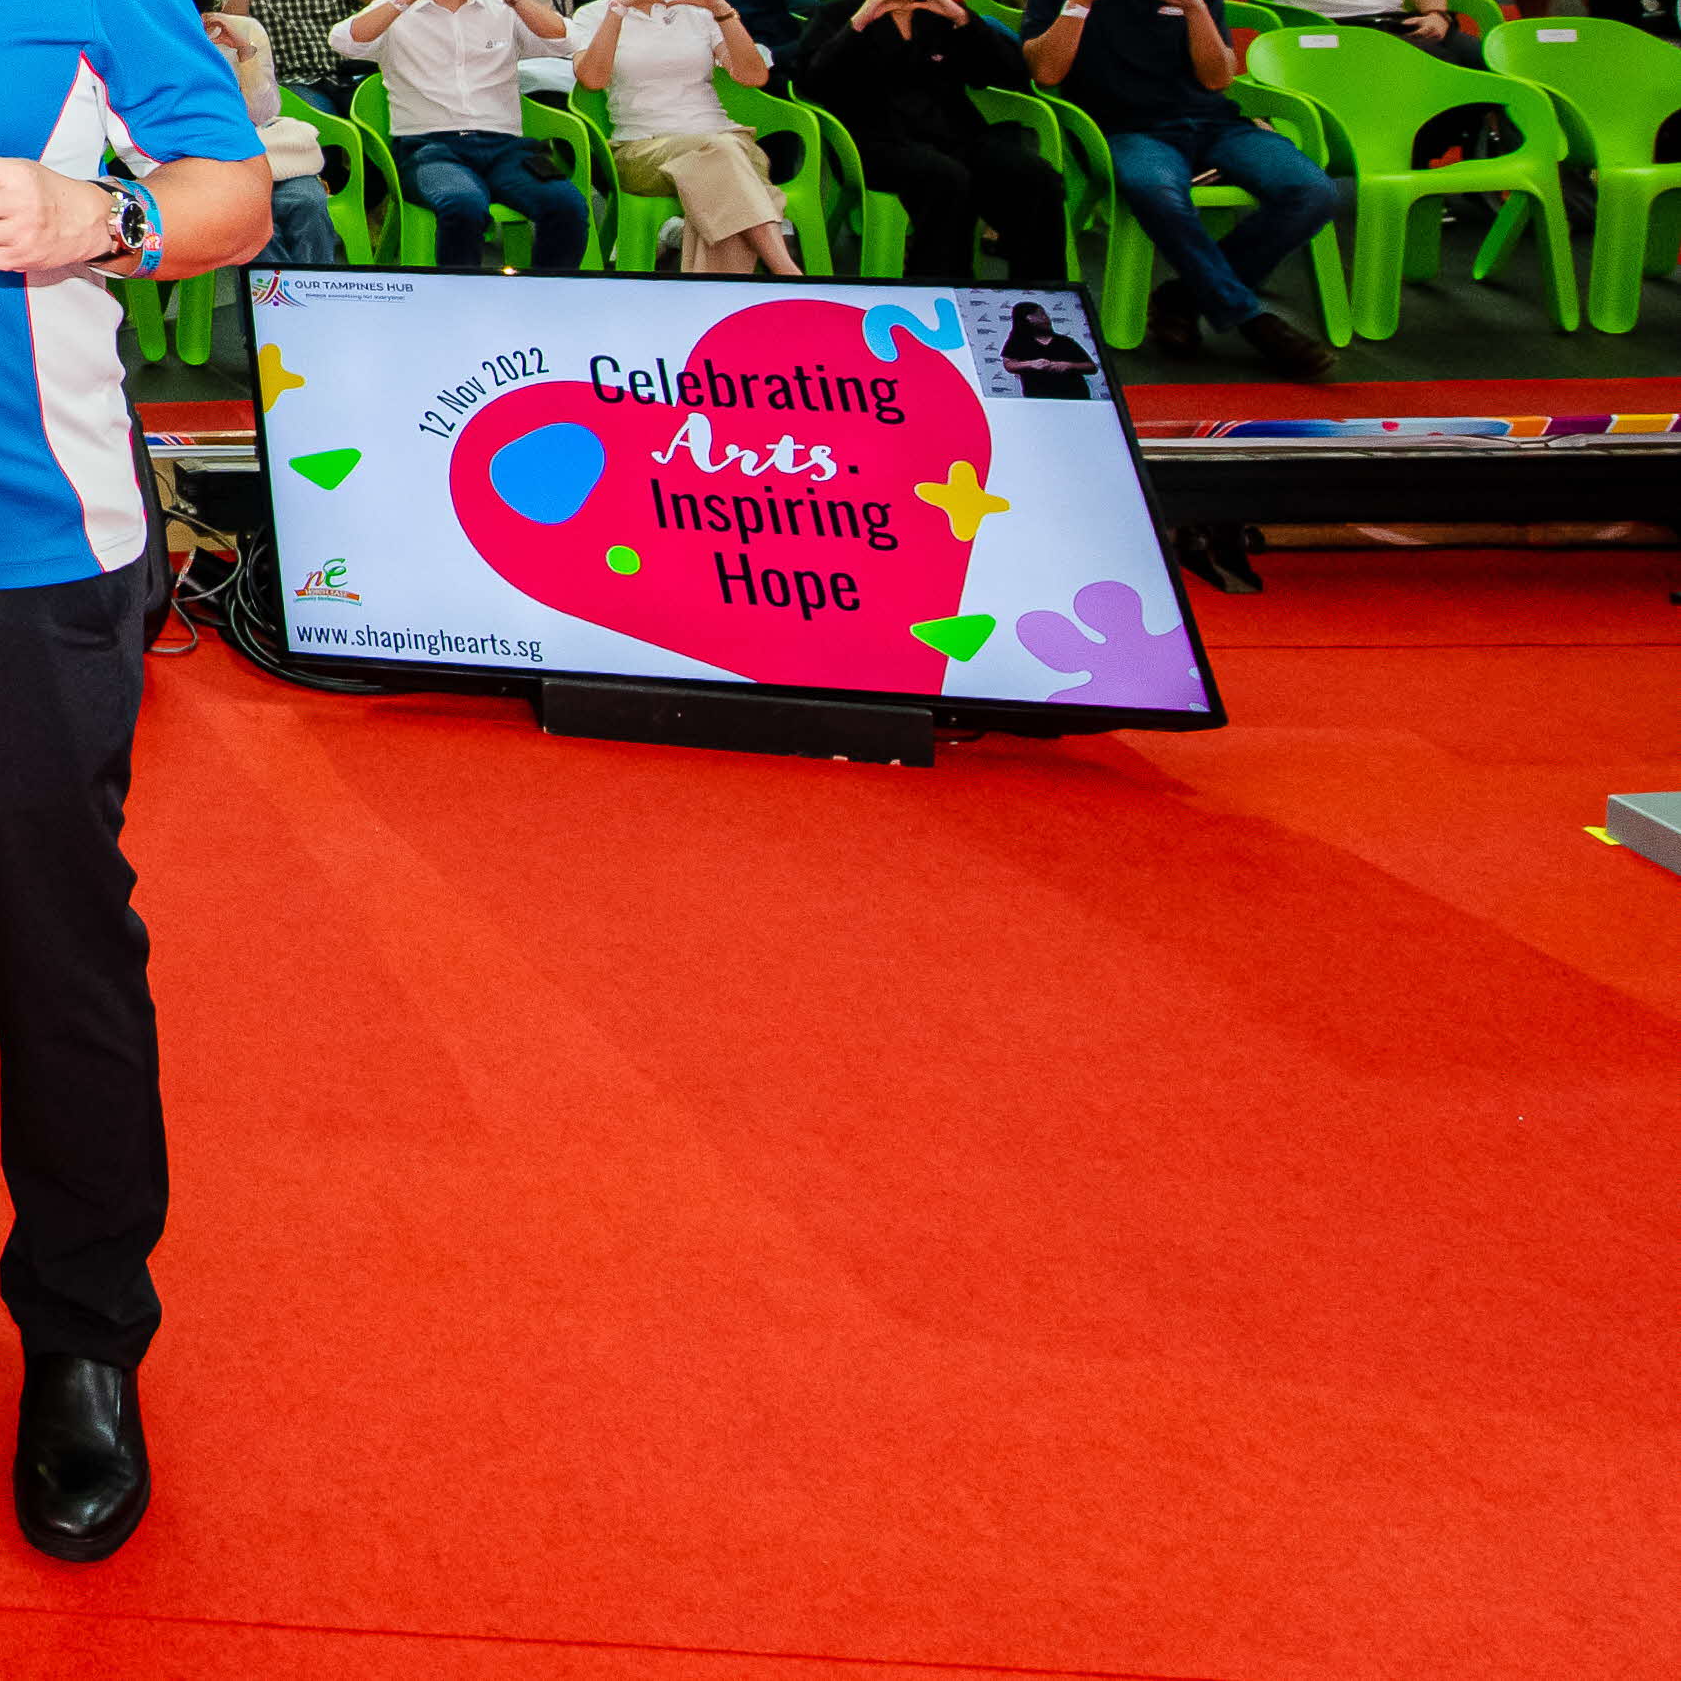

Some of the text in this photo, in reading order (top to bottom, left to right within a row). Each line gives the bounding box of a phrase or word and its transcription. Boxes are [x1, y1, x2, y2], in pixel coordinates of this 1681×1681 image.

[294, 280, 414, 293] OUR TAMPINES HUB
[419, 347, 550, 439] 12 Nov 2022
[589, 355, 905, 425] Celebrating
[650, 478, 899, 551] Inspiring
[714, 551, 861, 620] Hope
[296, 625, 543, 662] www.shapinghearts.sg
